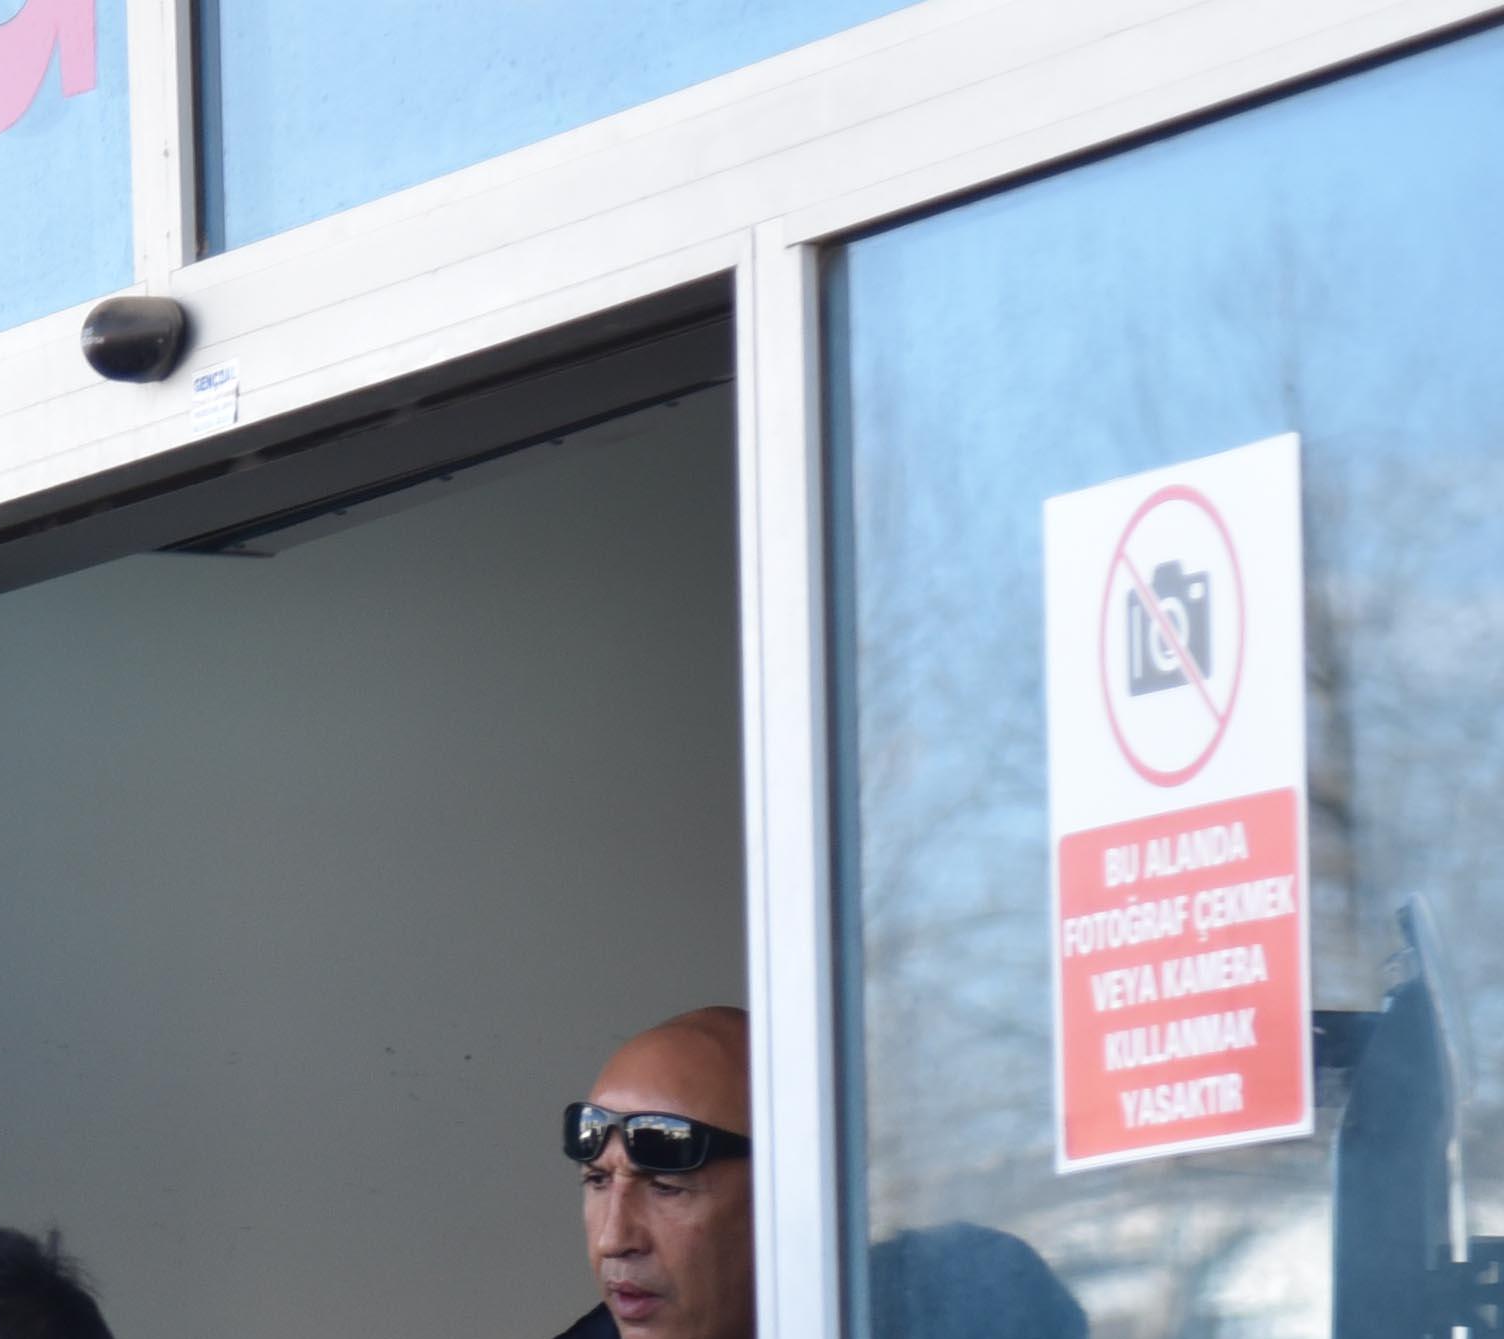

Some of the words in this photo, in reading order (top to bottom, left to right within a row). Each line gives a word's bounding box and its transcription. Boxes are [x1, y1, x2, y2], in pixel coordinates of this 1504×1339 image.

[1104, 844, 1139, 888] BU
[1143, 821, 1249, 878] ALANDA
[1063, 894, 1189, 957] FOTOĞRAF
[1194, 874, 1296, 942] ÇEKMEK
[1091, 964, 1158, 1012] VEYA
[1162, 944, 1269, 999] KAMERA
[1104, 1007, 1257, 1072] KULLANMAK
[1120, 1073, 1243, 1128] YASAKTIR
